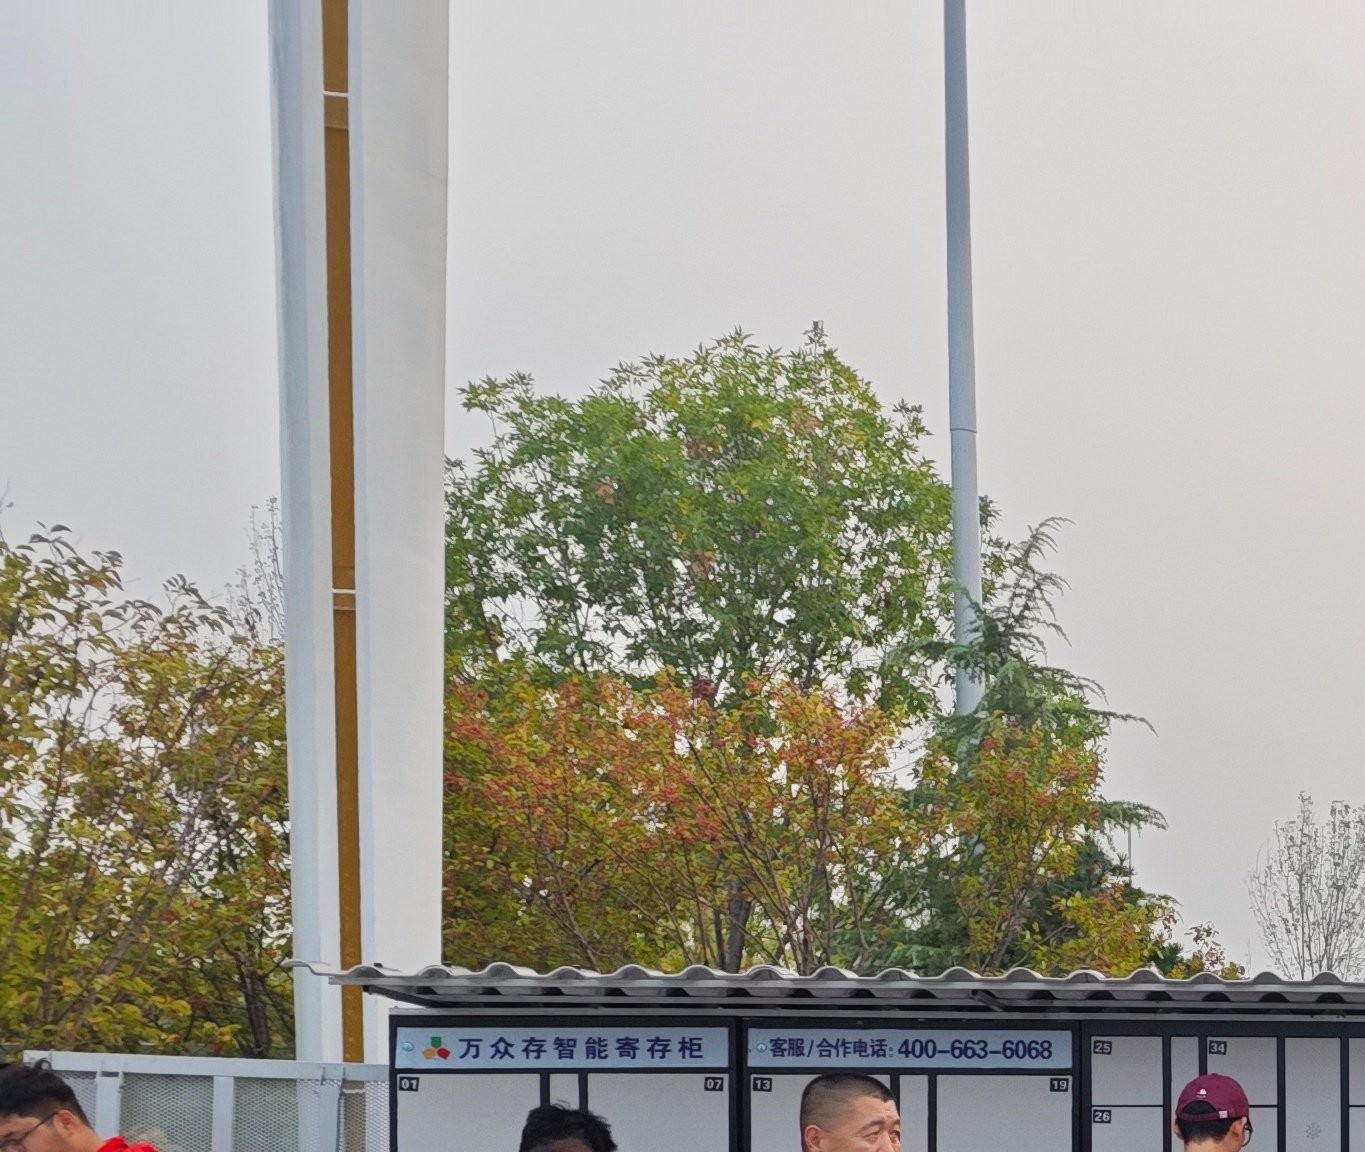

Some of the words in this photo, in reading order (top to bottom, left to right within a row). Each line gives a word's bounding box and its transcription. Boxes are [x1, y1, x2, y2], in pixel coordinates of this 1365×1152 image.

[457, 1036, 704, 1061] 万众存智能寄存柜
[897, 1038, 1053, 1060] 400-663-6068
[1094, 1042, 1111, 1053] 25
[1210, 1042, 1226, 1053] 34
[401, 1078, 417, 1090] 01
[706, 1078, 722, 1090] 07
[755, 1079, 771, 1090] 13
[1052, 1080, 1067, 1090] 19
[1094, 1111, 1111, 1122] 26
